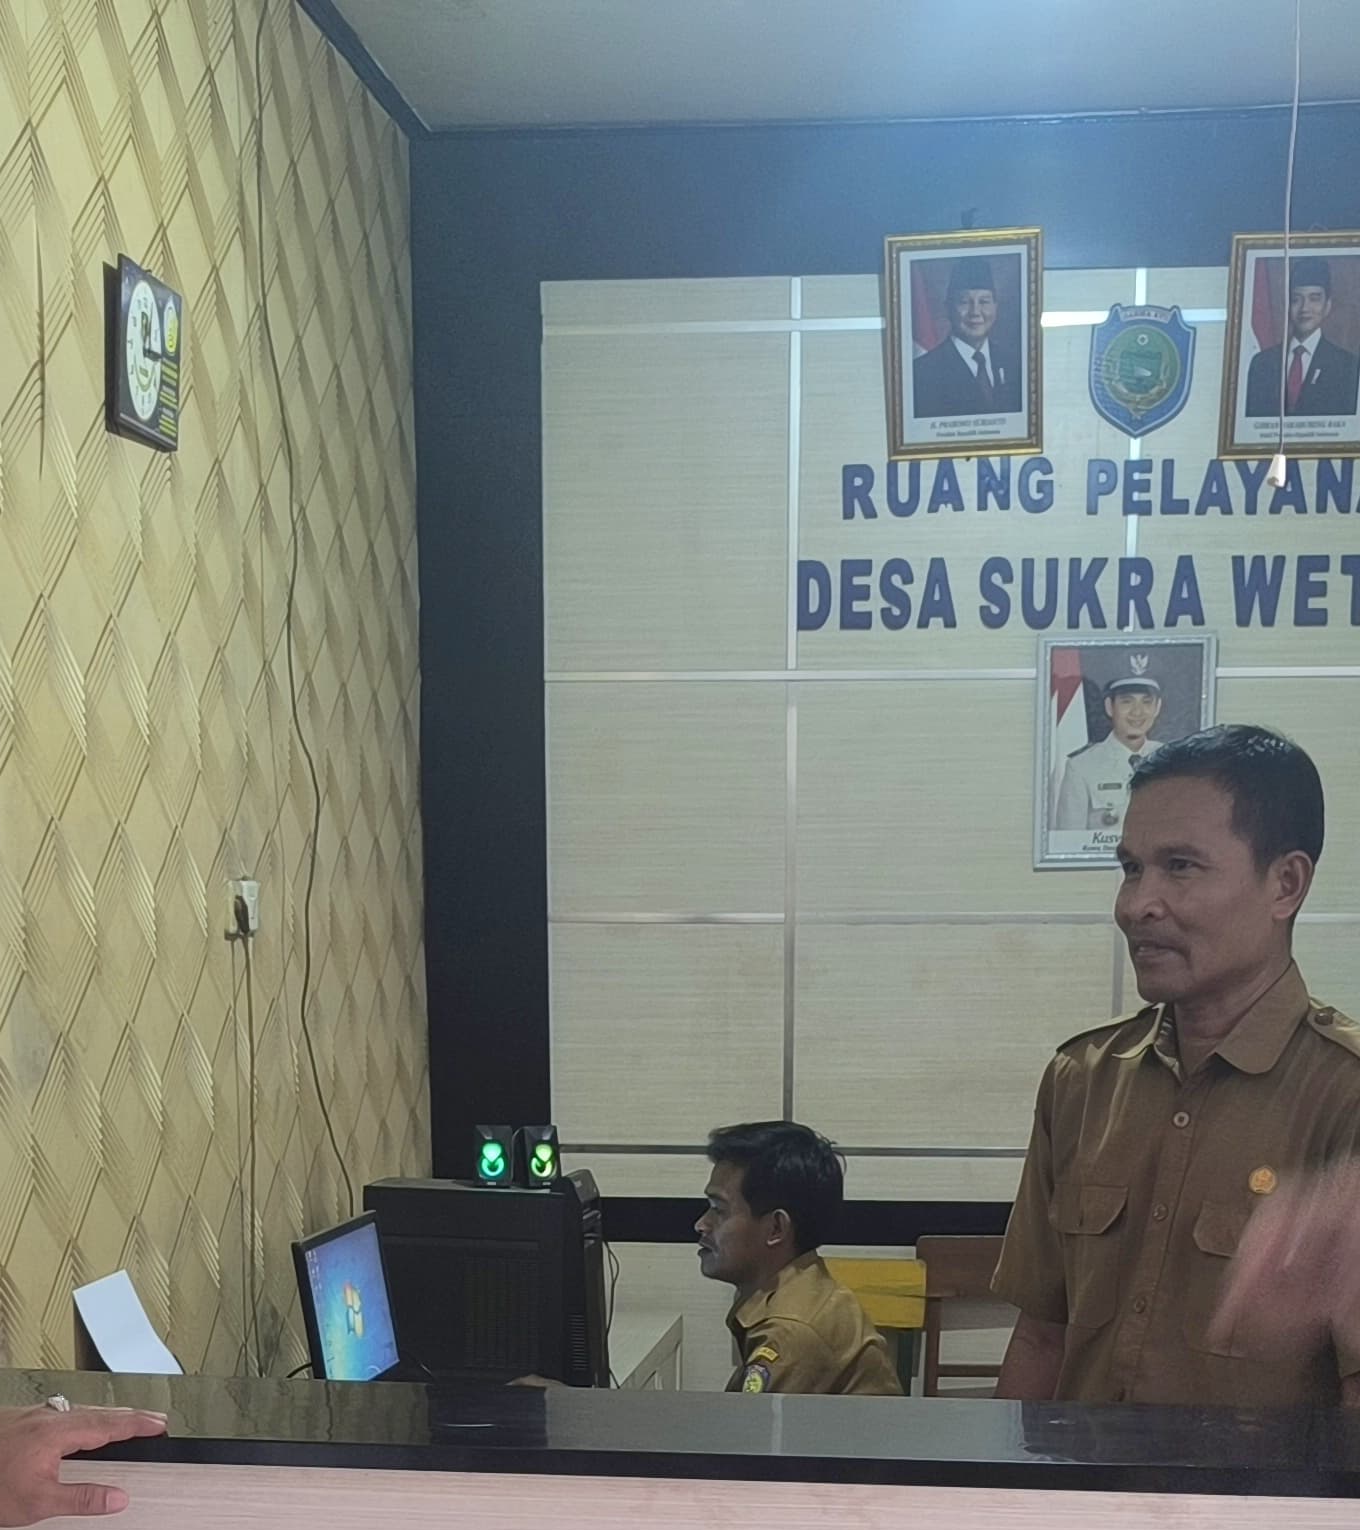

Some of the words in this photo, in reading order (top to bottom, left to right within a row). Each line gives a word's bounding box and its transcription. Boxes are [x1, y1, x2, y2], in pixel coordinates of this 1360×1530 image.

[842, 457, 1054, 519] RUANG
[797, 557, 957, 631] DESA
[979, 556, 1205, 630] SUKRA
